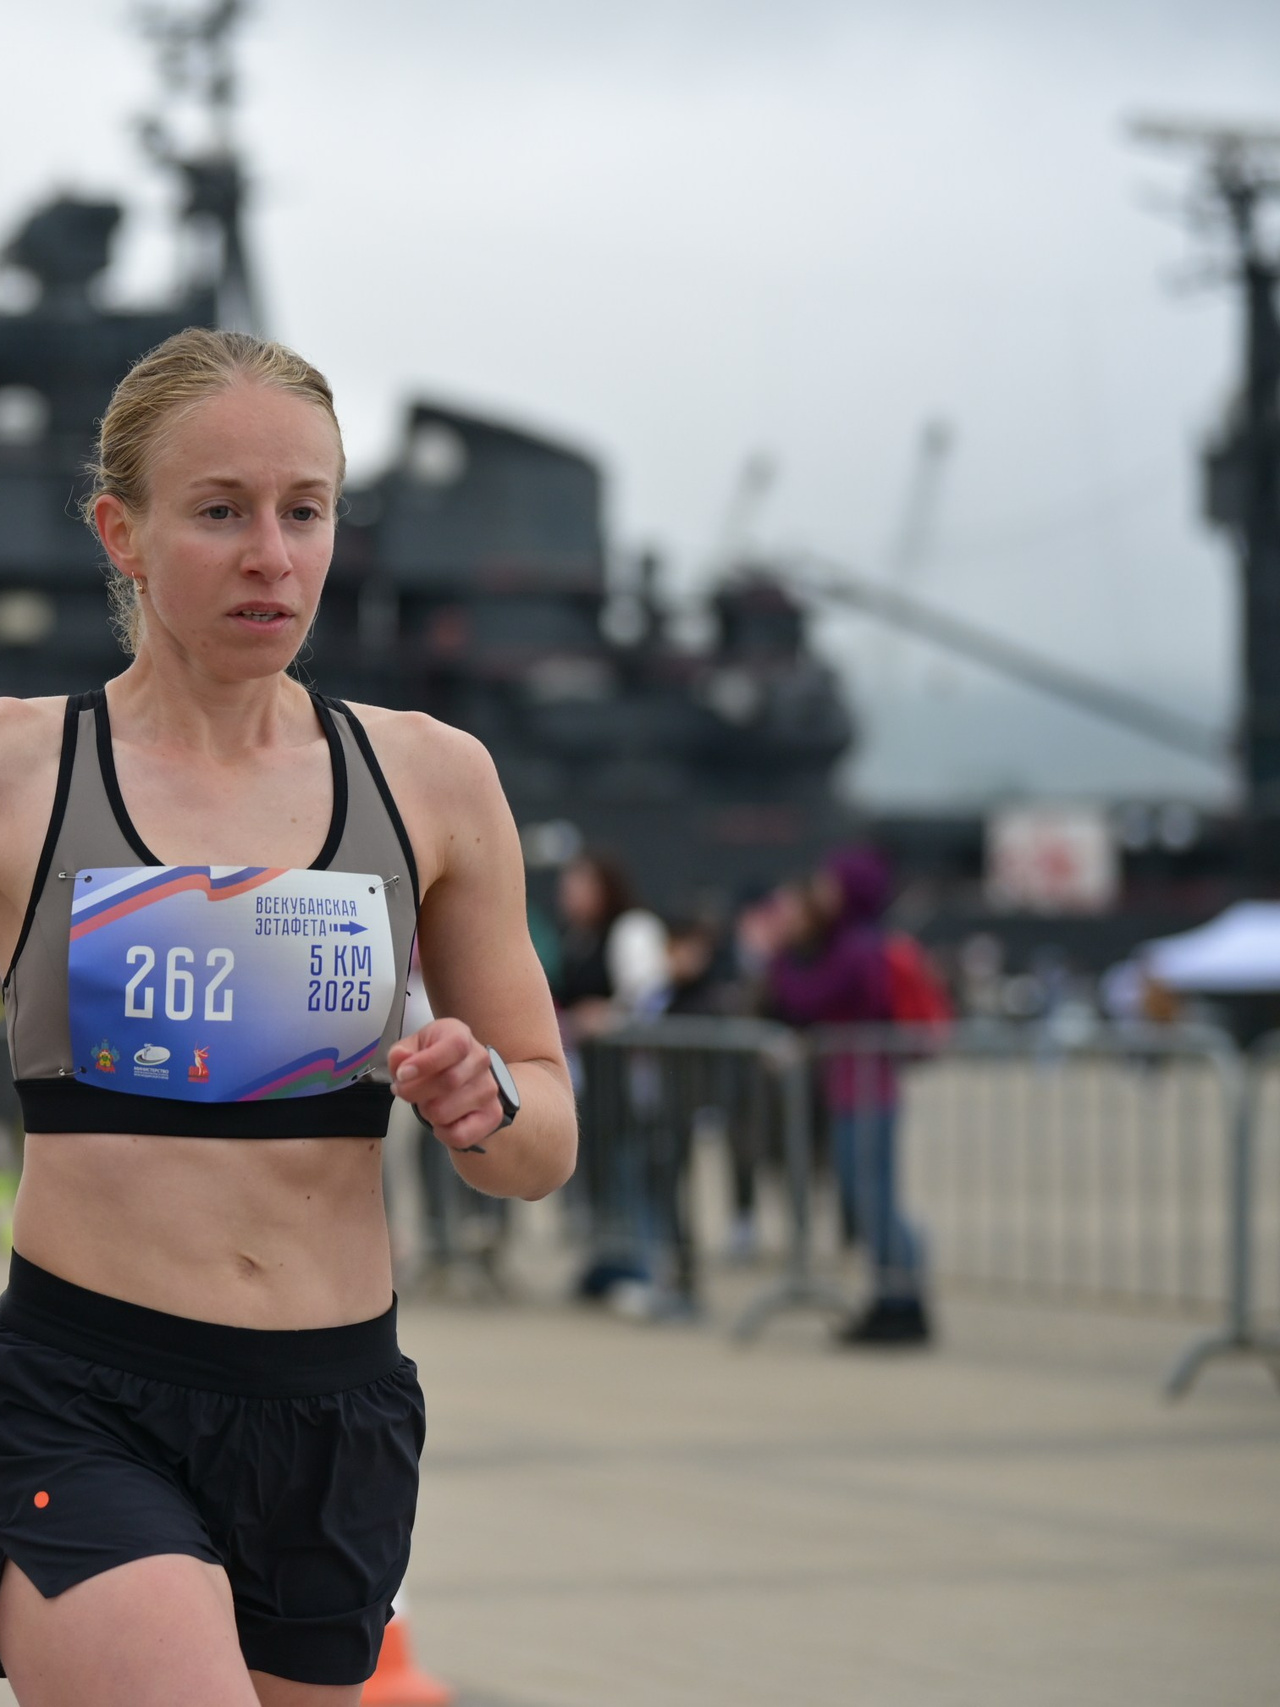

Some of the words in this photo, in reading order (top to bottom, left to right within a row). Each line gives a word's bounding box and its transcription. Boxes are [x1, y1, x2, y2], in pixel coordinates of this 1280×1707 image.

[256, 896, 357, 917] ВСЕКУБАНСКАЯ
[255, 917, 327, 937] ЭСТАФЕТА
[310, 944, 323, 977] 5
[334, 945, 372, 977] КМ
[124, 945, 235, 1021] 262
[308, 980, 371, 1012] 2025
